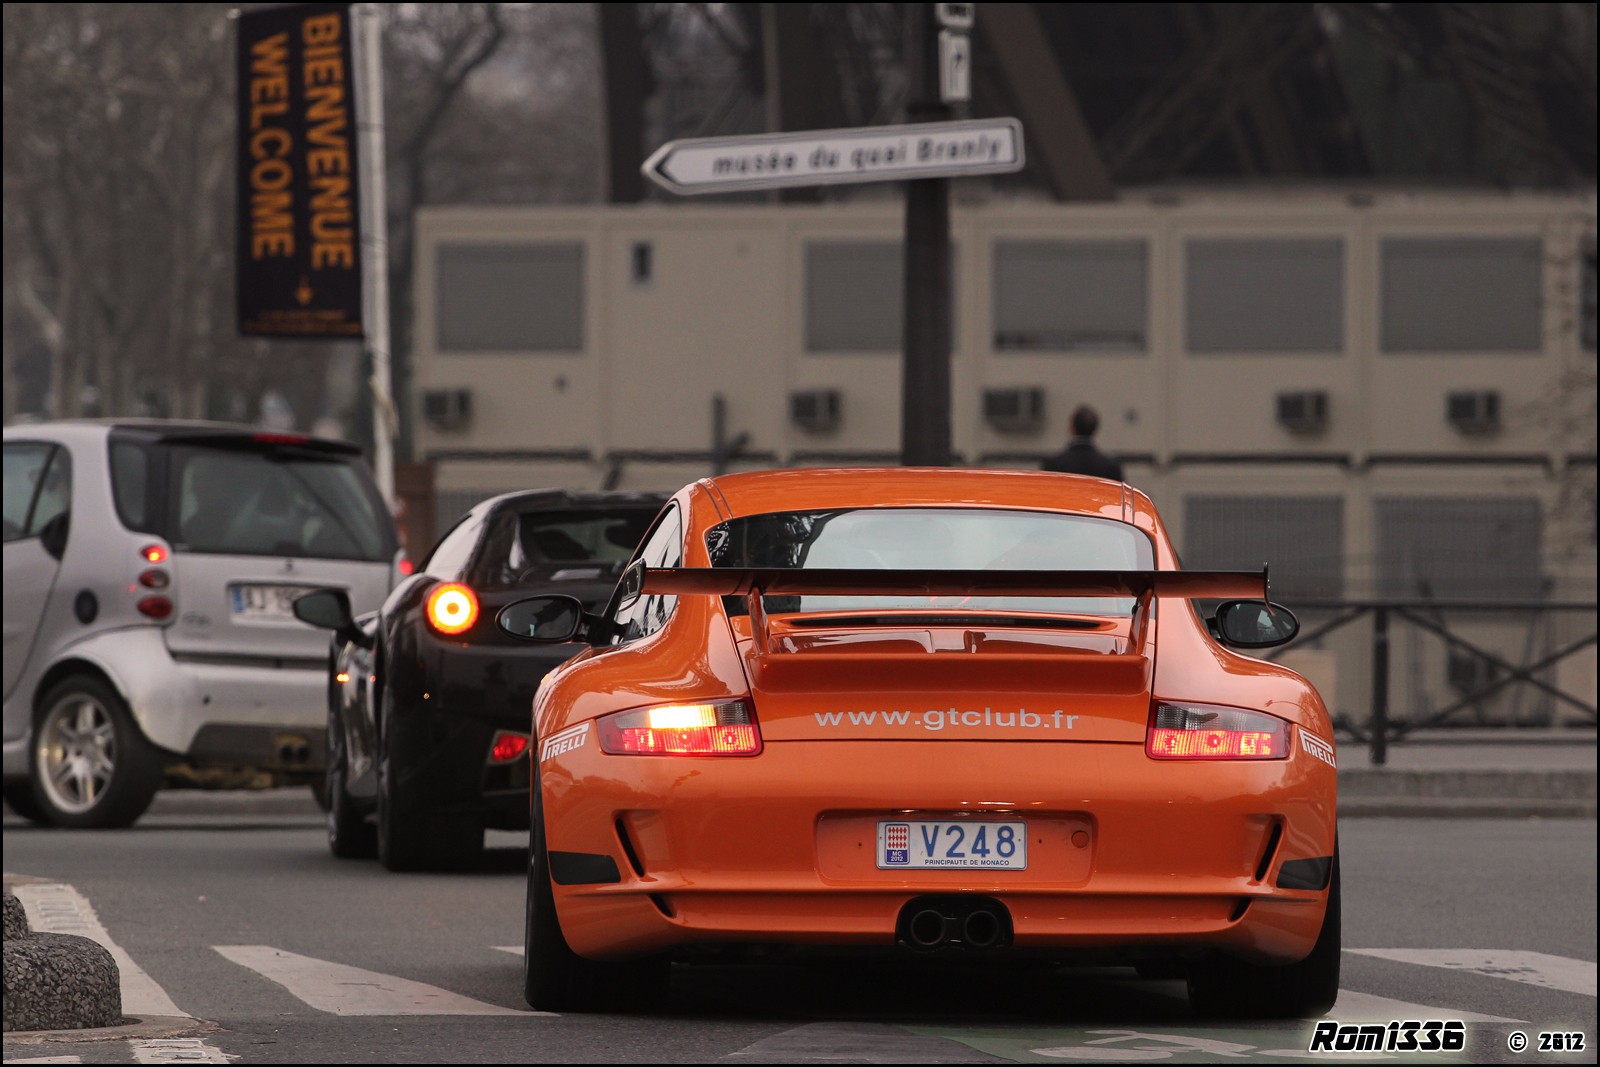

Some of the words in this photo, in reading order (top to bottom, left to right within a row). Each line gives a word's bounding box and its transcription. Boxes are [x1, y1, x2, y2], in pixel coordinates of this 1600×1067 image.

[251, 31, 295, 260] WELCOME
[302, 13, 353, 270] BIENVENUE
[713, 147, 798, 176] musée
[808, 145, 840, 169] du
[851, 139, 907, 173] quai
[916, 132, 1002, 164] Branly
[814, 707, 1079, 730] www.gtclub.fr
[541, 722, 590, 763] PIRELLI
[1298, 728, 1337, 769] PIRELLI
[921, 825, 1016, 858] V248
